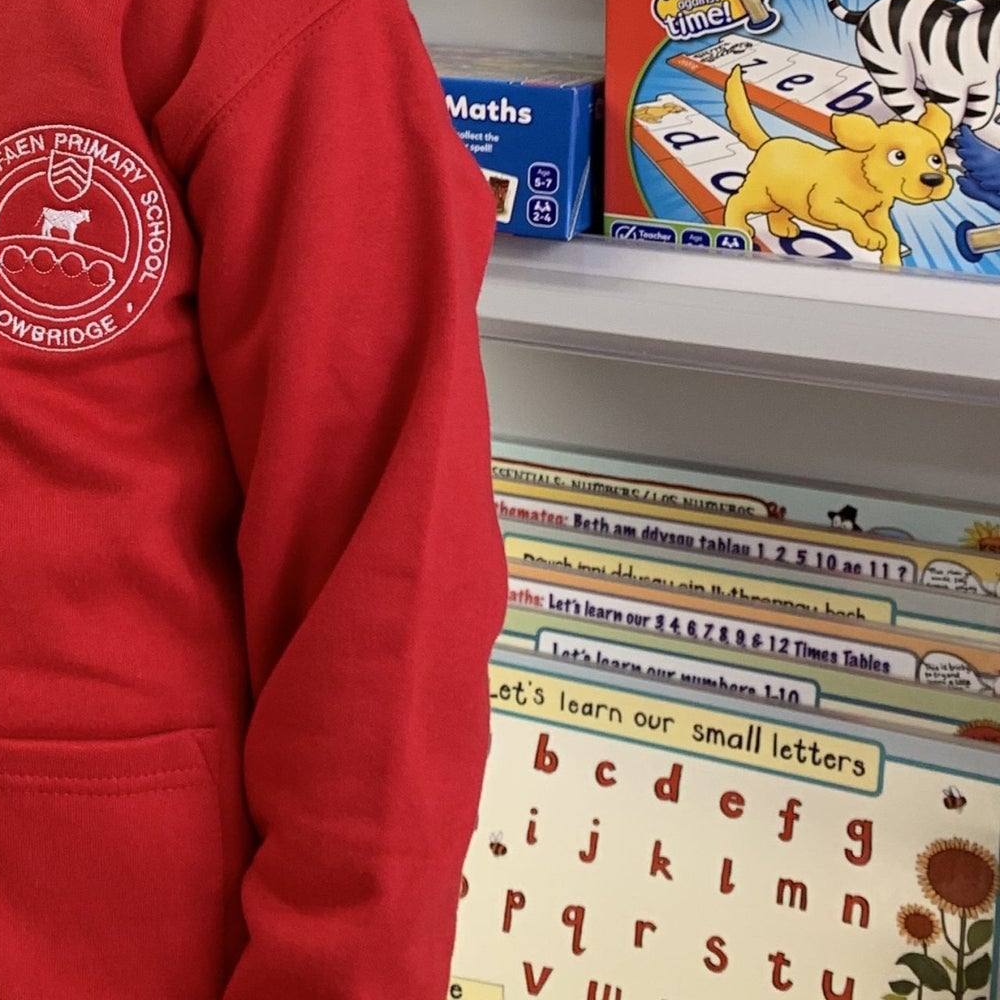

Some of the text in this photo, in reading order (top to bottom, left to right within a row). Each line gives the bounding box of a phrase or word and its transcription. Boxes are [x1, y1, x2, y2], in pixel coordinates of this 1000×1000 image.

[664, 1, 732, 35] time!
[445, 95, 532, 124] Maths
[485, 132, 499, 142] the
[534, 178, 553, 189] 5-7
[537, 168, 551, 178] Age
[54, 132, 148, 183] PRIMARY
[139, 189, 165, 284] SCHOOL
[533, 211, 552, 223] 2-4
[638, 229, 672, 243] Teacher
[574, 512, 609, 533] Beth
[614, 524, 636, 539] am
[776, 547, 786, 563] 2
[817, 552, 837, 571] 10
[843, 560, 861, 575] ac
[870, 561, 888, 580] 11
[548, 593, 580, 615] Let's
[585, 600, 622, 623] learn
[626, 612, 650, 628] our
[752, 633, 763, 648] &
[770, 635, 789, 654] 12
[794, 641, 838, 664] Times
[843, 650, 891, 674] Tables
[560, 690, 623, 725] learn
[634, 710, 676, 734] our
[692, 722, 762, 757] small
[772, 732, 867, 778] letters
[534, 733, 874, 866] b c d e f g
[525, 807, 871, 928] i j k l m n
[501, 888, 856, 1000] p q r s t u
[523, 961, 553, 996] v
